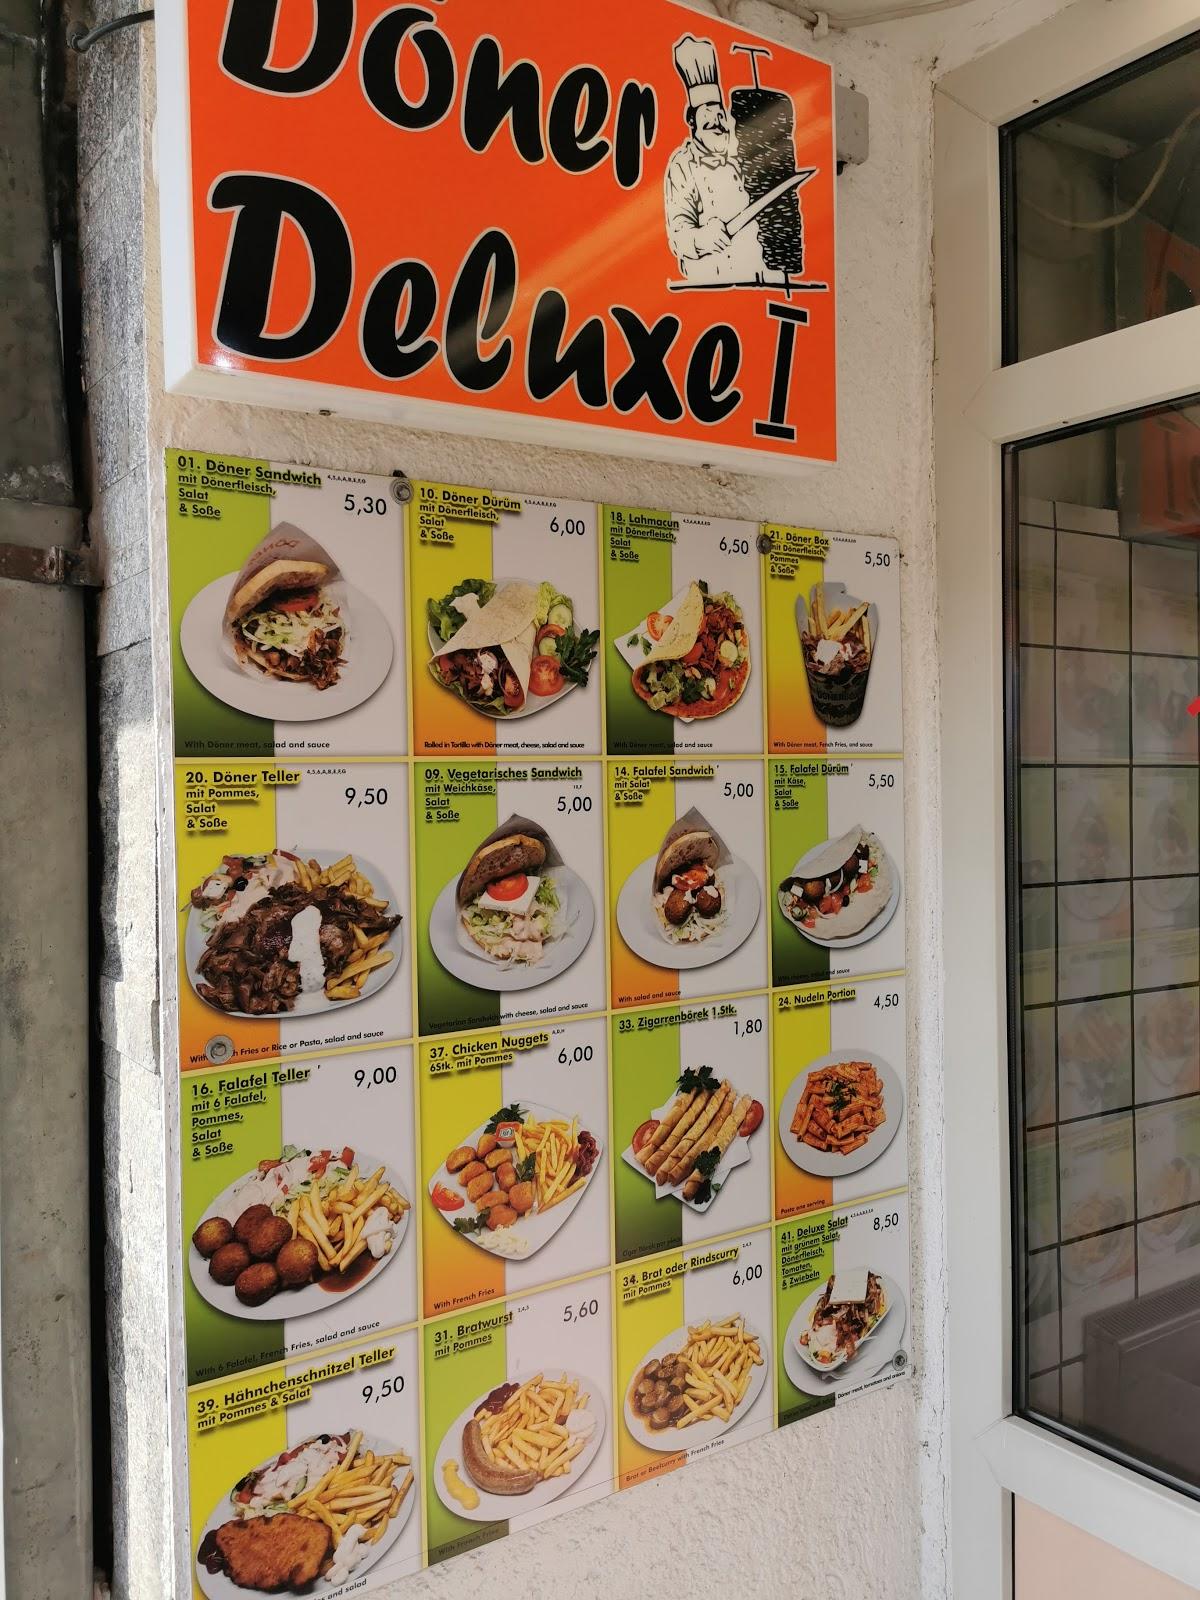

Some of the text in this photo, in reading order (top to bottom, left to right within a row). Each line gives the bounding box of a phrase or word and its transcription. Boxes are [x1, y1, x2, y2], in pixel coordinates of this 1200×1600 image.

[212, 174, 742, 423] Deluxe
[178, 456, 200, 470] 01.
[206, 460, 251, 476] Döner
[256, 467, 321, 485] Sandwich
[179, 474, 277, 495] mit Dönerfleisch,
[179, 488, 208, 500] Salat
[420, 488, 438, 500] 10.
[443, 491, 477, 506] Döner
[483, 496, 521, 509] Dürüm
[180, 503, 221, 517] & Soße
[344, 494, 387, 515] 5,30
[420, 504, 499, 520] mit Dönerfleisch,
[420, 516, 444, 526] Salat
[550, 517, 585, 536] 6,00
[611, 512, 626, 523] 18.
[629, 514, 679, 529] Lahmacun
[421, 530, 454, 541] & Soße
[611, 526, 677, 541] mit Dönerfleisch,
[611, 537, 631, 547] Salat
[770, 531, 783, 541] 21.
[786, 533, 811, 544] Döner
[815, 536, 829, 546] Box
[719, 537, 748, 555] 6,50
[783, 544, 826, 556] Dönerfleisch,
[620, 551, 639, 560] Soße
[770, 554, 798, 564] Pommes
[865, 552, 890, 567] 5,50
[771, 566, 794, 575] & Soße
[186, 772, 208, 783] 20.
[213, 771, 257, 783] Döner
[262, 771, 299, 781] Teller
[425, 767, 582, 780] 09. Vegetarisches Sandwich
[615, 765, 714, 776] 14. Falafel Sandwich
[775, 765, 787, 773] 15.
[822, 764, 848, 772] Dürüm
[444, 784, 496, 792] Weichkäse,
[868, 774, 894, 789] 5,50
[186, 789, 259, 798] mit Pommes,
[345, 788, 387, 808] 9,50
[624, 792, 643, 800] Soße
[724, 783, 753, 799] 5,00
[187, 804, 215, 813] Salat
[426, 798, 450, 806] Salat
[557, 797, 592, 814] 5,00
[187, 819, 227, 828] & Soße
[426, 811, 459, 819] & Soße
[779, 989, 855, 1006] 24. Nudeln Portion
[874, 994, 898, 1010] 4,50
[619, 1005, 737, 1030] 33. Zigarrenbörek 1.Stk.
[734, 1019, 762, 1037] 1,80
[241, 1047, 259, 1055] Fries
[300, 1039, 322, 1048] Pasta,
[325, 1035, 345, 1044] salad
[364, 1030, 383, 1038] sauce
[430, 1033, 548, 1058] 37. Chicken Nuggets
[430, 1053, 513, 1072] 6Stk. mit Pommes
[558, 1046, 593, 1066] 6,00
[192, 1068, 310, 1096] 16. Falafel Teller
[354, 1067, 396, 1089] 9,00
[192, 1091, 266, 1112] mit 6 Falafel,
[192, 1112, 243, 1127] Pommes,
[192, 1130, 221, 1142] Salat
[193, 1143, 233, 1158] & Soße
[782, 1217, 848, 1241] 41. Deluxe Salat
[873, 1213, 898, 1231] 8,50
[782, 1232, 840, 1253] mit grünem Salat,
[782, 1247, 824, 1264] Dönerfleisch,
[623, 1275, 638, 1287] 34.
[642, 1269, 662, 1281] Brat
[666, 1261, 687, 1274] oder
[691, 1247, 739, 1267] Rindscurry
[733, 1265, 762, 1285] 6,00
[782, 1263, 812, 1275] Tomaten,
[790, 1271, 819, 1285] Zwiebeln
[623, 1280, 671, 1299] mit Pommes
[434, 1288, 495, 1310] With French Fries
[563, 1300, 598, 1323] 5,60
[291, 1341, 313, 1351] Fries,
[316, 1332, 338, 1344] salad
[340, 1328, 355, 1337] and
[358, 1321, 380, 1333] sauce
[434, 1312, 513, 1343] 31. Bratwurst
[435, 1334, 492, 1357] mit Pommes
[197, 1348, 394, 1413] 39. Hähnchenschnitzel Teller
[362, 1376, 404, 1404] 9,50
[197, 1389, 311, 1429] mit Pommes & Salat
